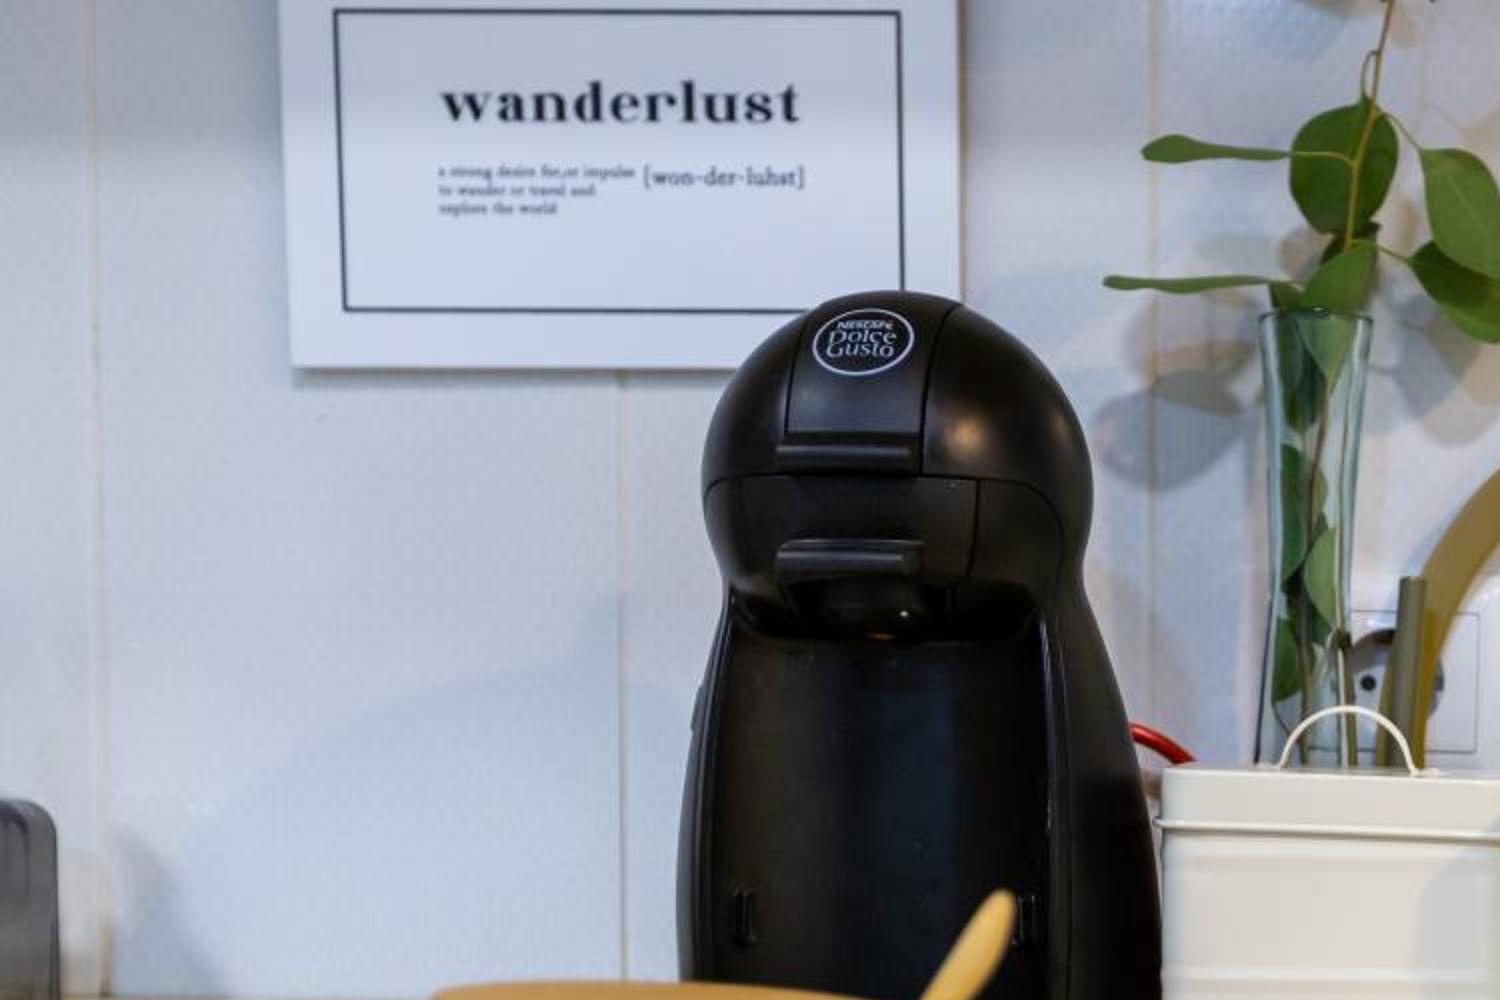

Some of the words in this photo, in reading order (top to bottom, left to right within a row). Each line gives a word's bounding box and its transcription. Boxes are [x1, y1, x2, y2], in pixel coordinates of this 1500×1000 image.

[440, 79, 800, 124] wanderlust
[498, 162, 536, 177] desire
[584, 163, 635, 180] impulse
[438, 185, 452, 196] to
[457, 184, 506, 196] wander
[529, 184, 566, 197] travel
[571, 184, 596, 196] and
[439, 203, 488, 217] explore
[493, 203, 514, 214] the
[519, 203, 557, 215] world
[829, 330, 896, 344] Dolce
[826, 343, 894, 357] Gusto
